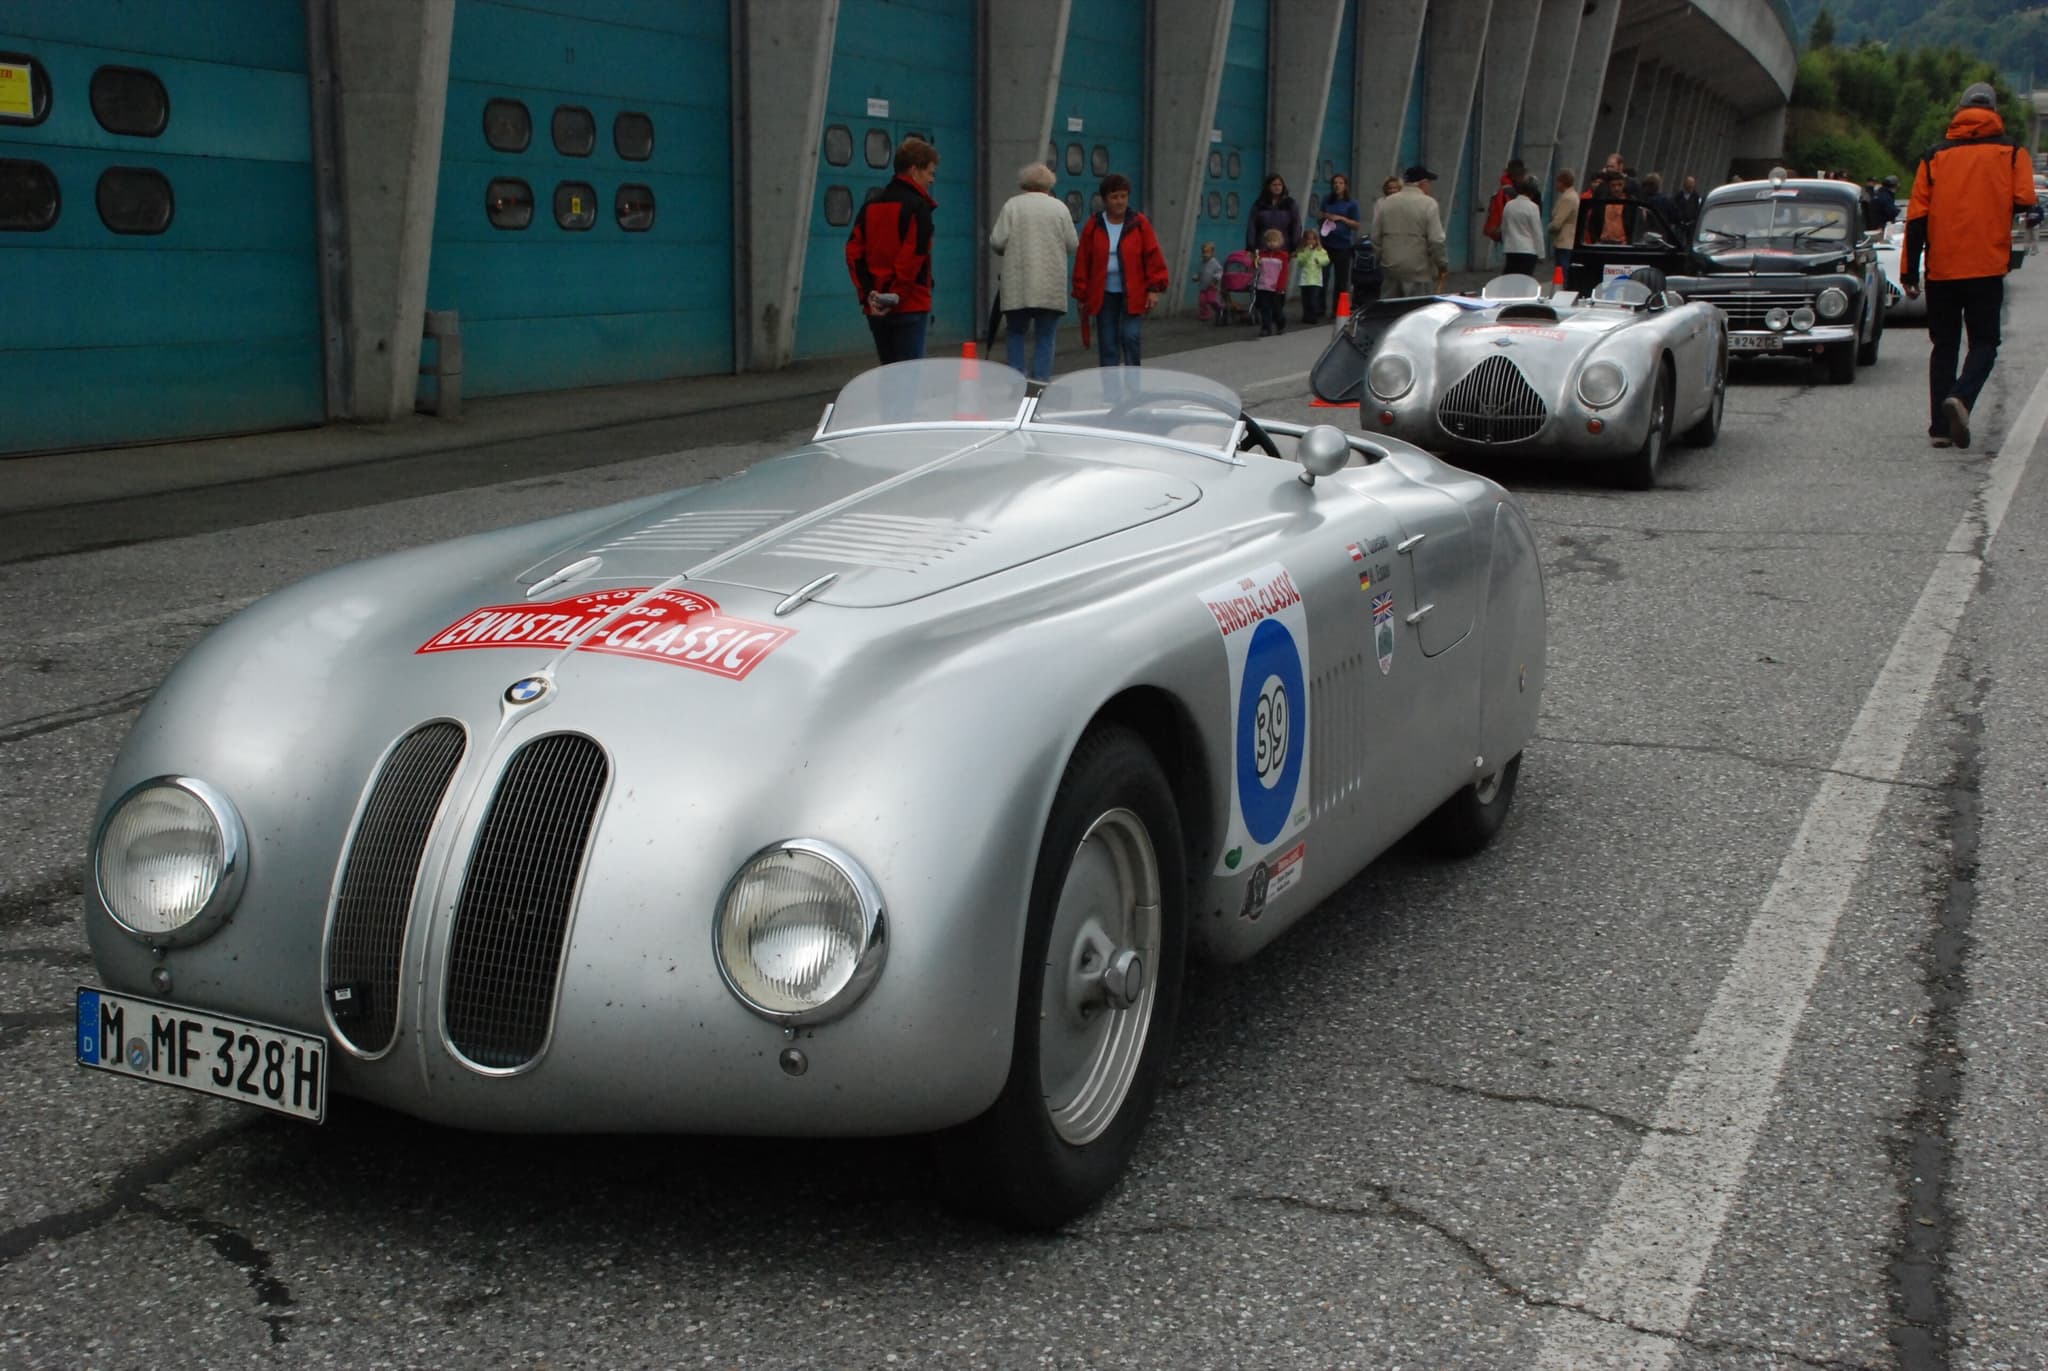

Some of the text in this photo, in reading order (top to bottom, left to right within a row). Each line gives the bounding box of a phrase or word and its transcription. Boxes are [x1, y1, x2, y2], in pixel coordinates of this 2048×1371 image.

[1742, 336, 1762, 348] 242
[586, 604, 668, 617] 2008
[1207, 570, 1301, 636] ENNSTAL-CLASSIC
[435, 611, 775, 669] ENNSTAL-CLASSIC
[1255, 685, 1288, 778] 39
[83, 1036, 93, 1052] D
[101, 1002, 124, 1064] M
[151, 1014, 203, 1078] MF
